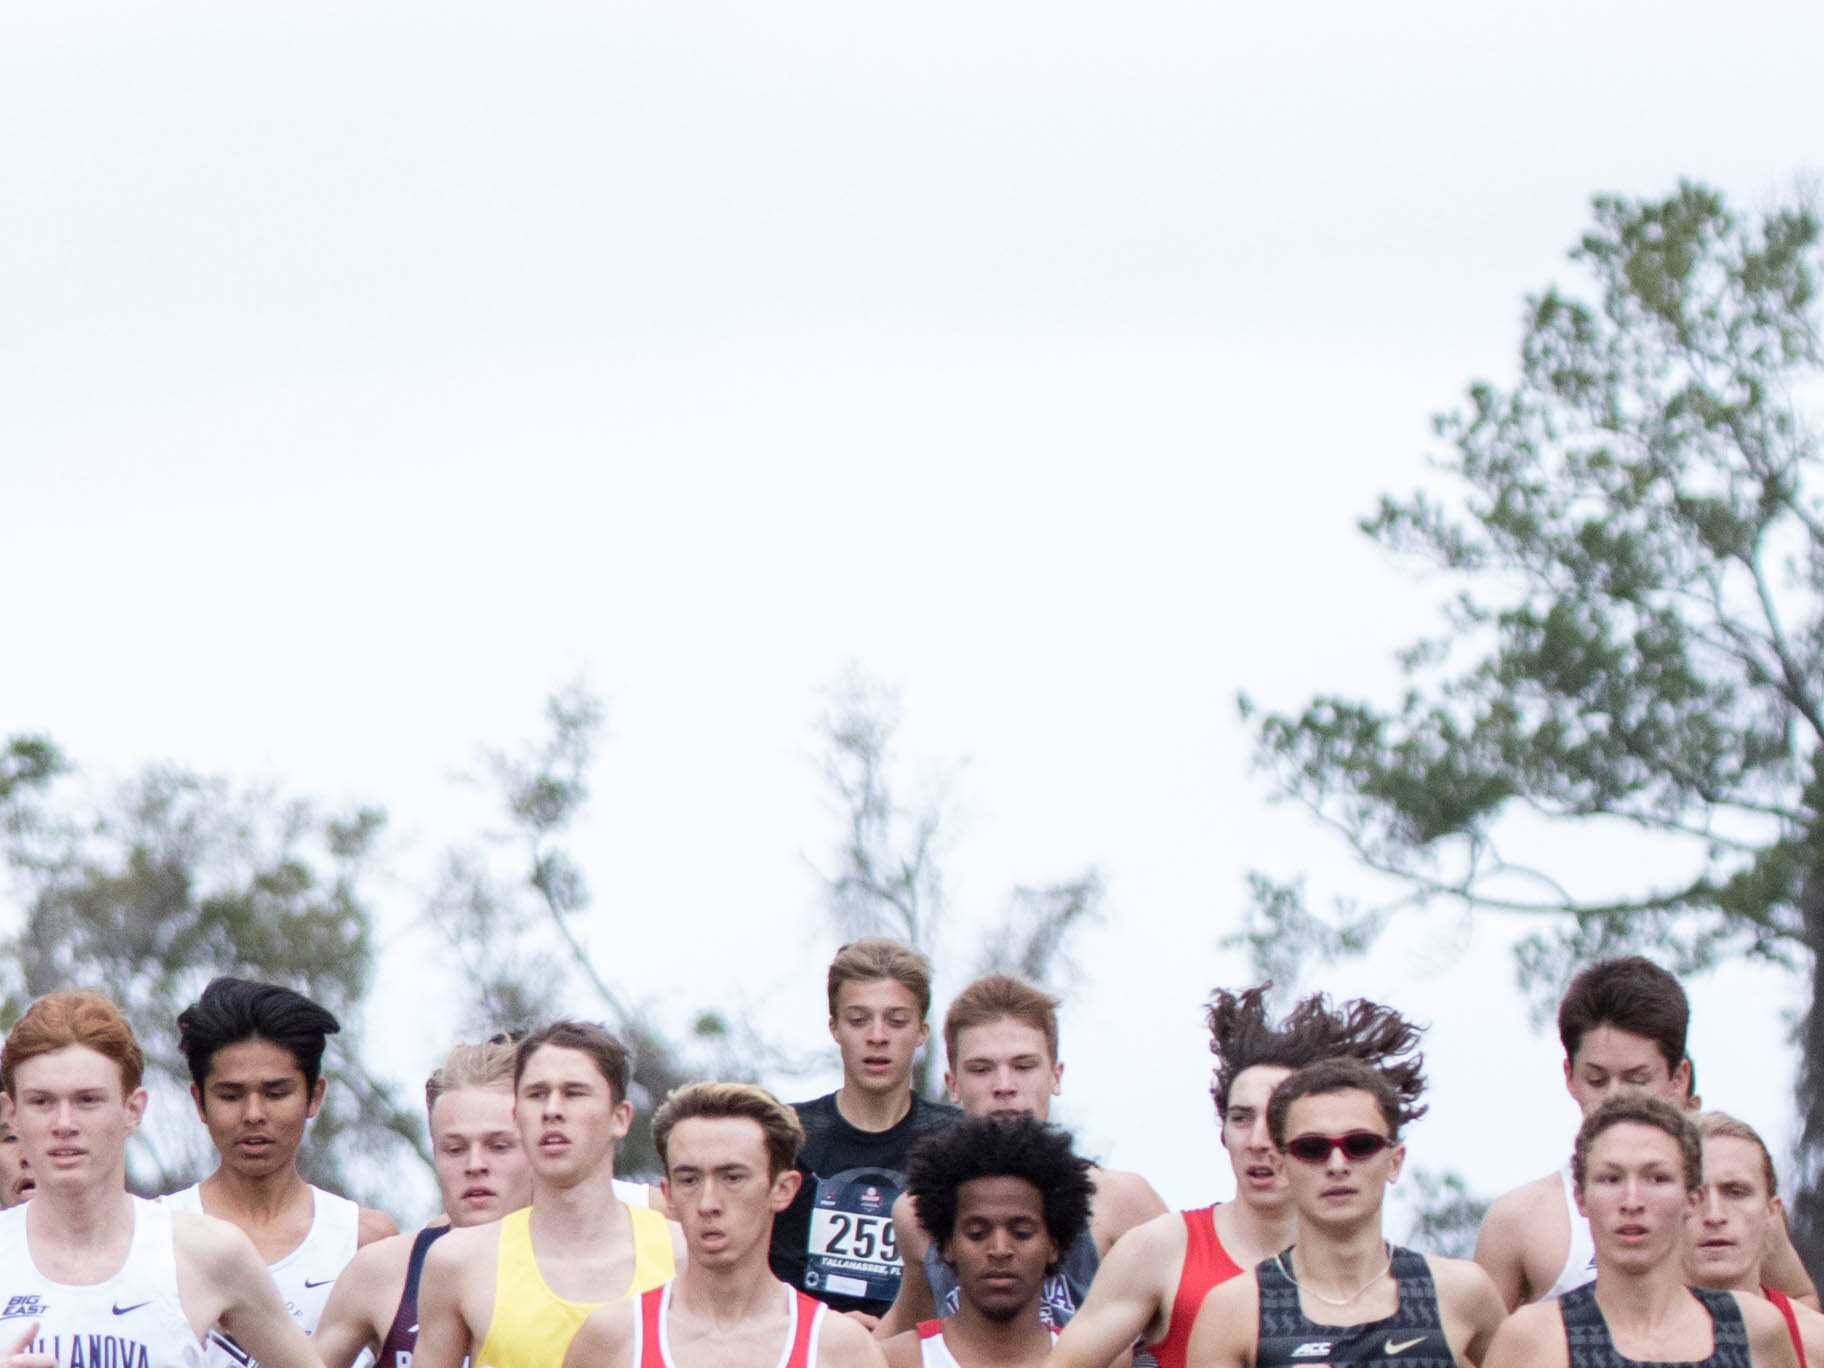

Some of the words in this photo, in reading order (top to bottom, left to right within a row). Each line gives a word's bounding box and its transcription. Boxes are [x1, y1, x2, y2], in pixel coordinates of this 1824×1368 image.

[826, 1214, 900, 1262] 259
[8, 1295, 41, 1306] BIG
[2, 1305, 50, 1316] EAST
